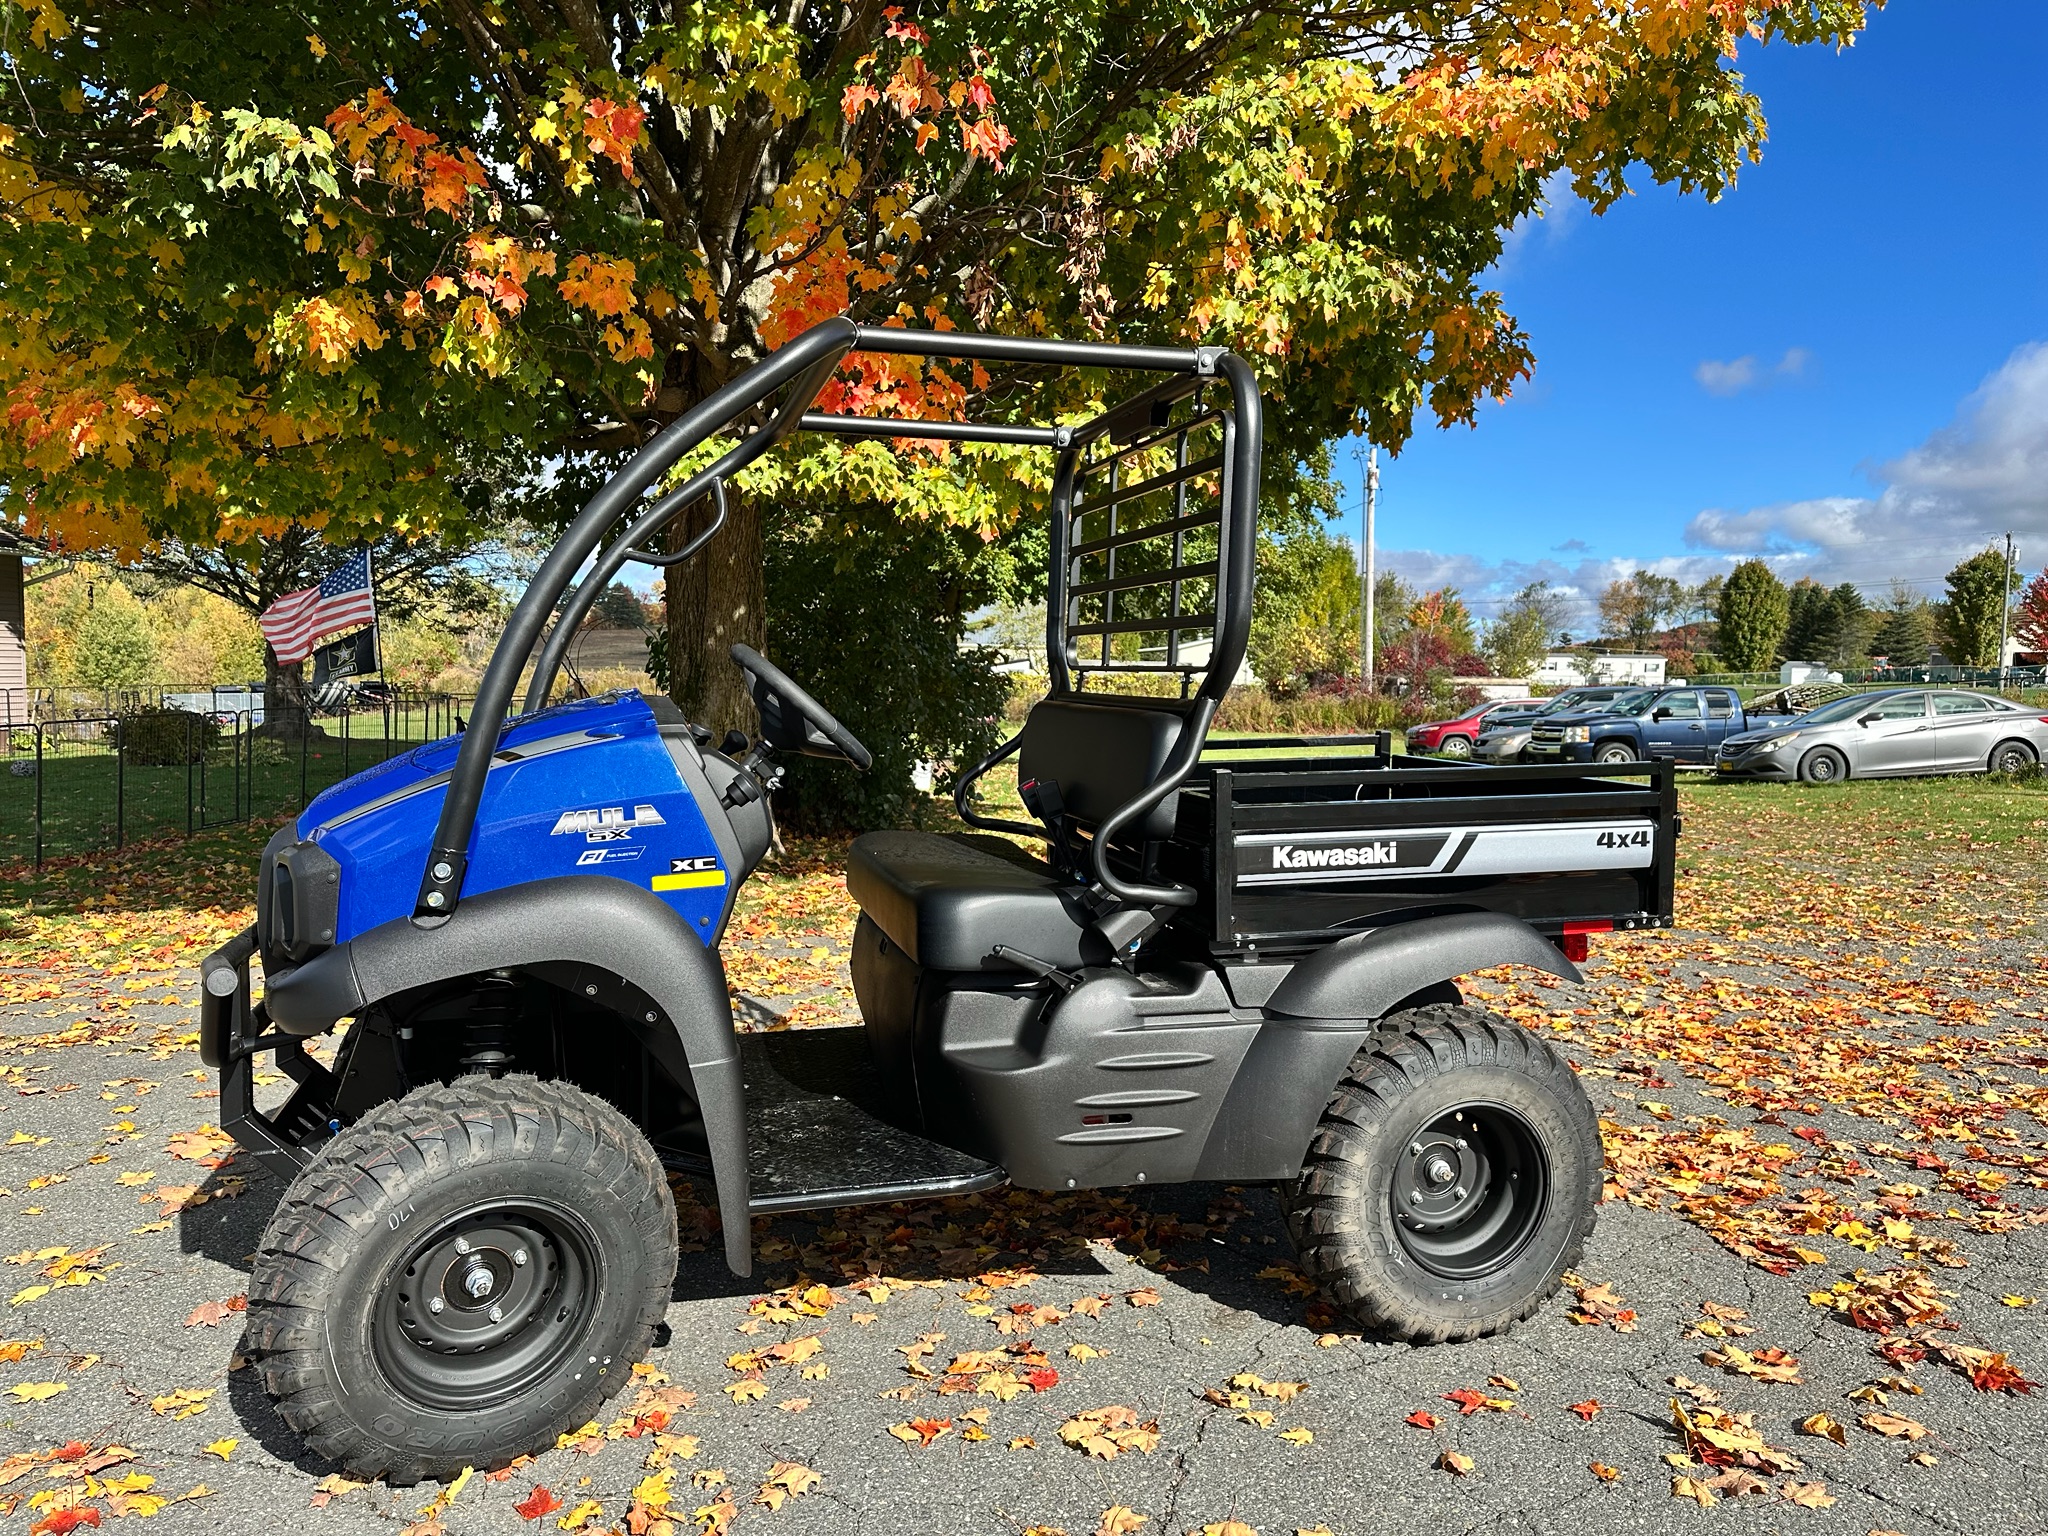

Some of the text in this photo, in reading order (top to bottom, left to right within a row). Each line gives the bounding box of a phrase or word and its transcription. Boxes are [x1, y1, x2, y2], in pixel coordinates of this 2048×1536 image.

[550, 804, 667, 836] MULE
[587, 828, 632, 843] SX
[1596, 830, 1650, 849] 4x4
[1272, 841, 1398, 869] Kawasaki
[672, 858, 716, 872] XC
